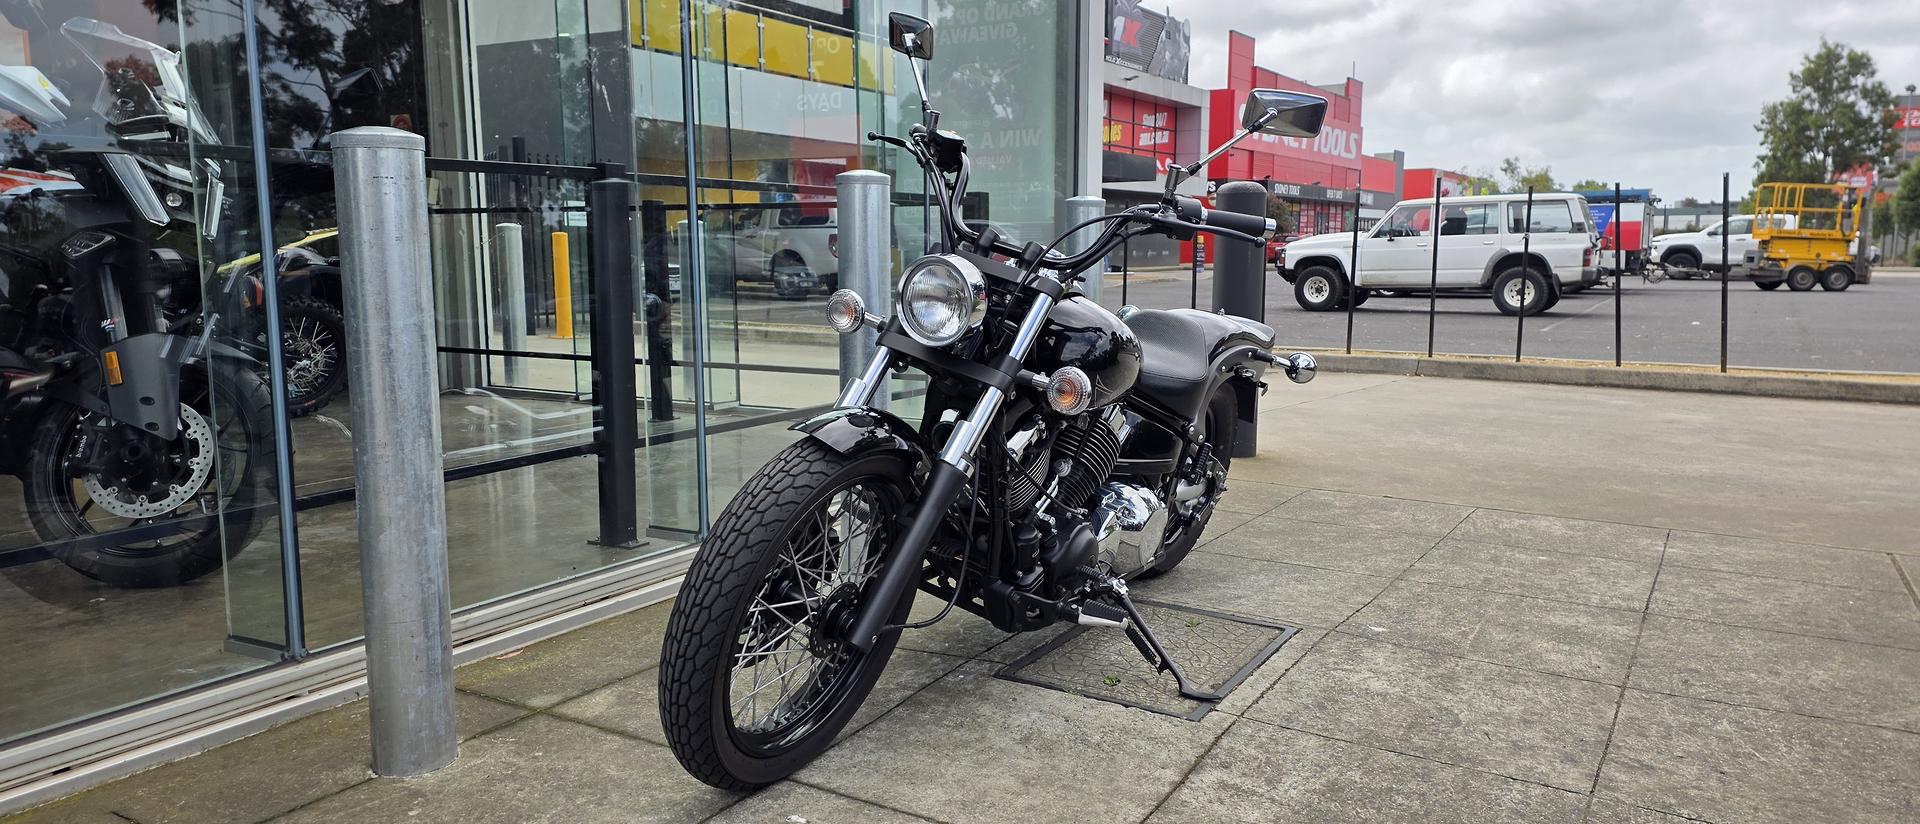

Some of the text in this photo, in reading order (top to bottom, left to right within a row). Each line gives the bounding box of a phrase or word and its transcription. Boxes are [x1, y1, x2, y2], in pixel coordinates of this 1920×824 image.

[1274, 183, 1300, 195] SYDNEY TOOLS
[75, 435, 87, 457] brembo
